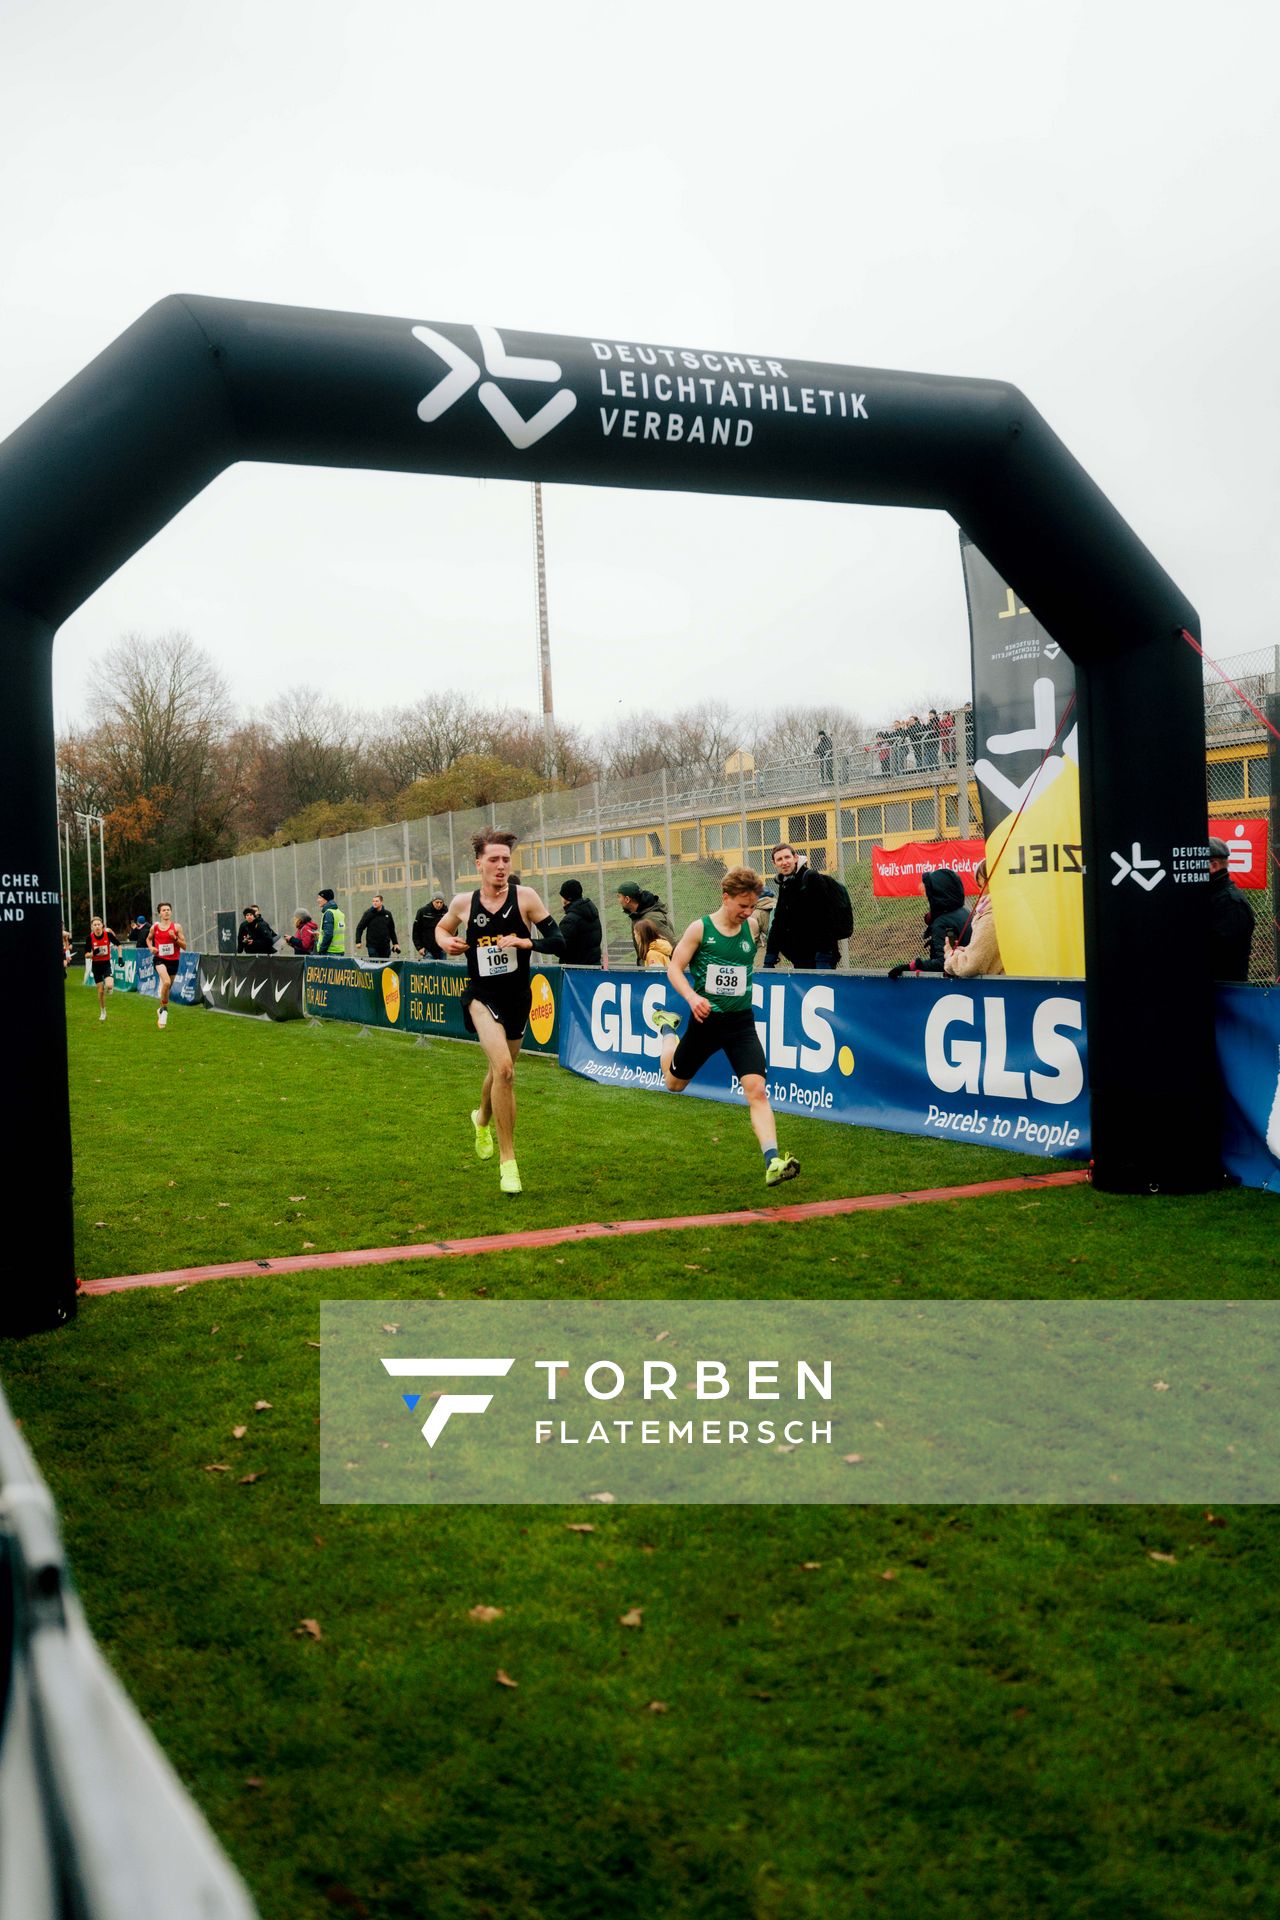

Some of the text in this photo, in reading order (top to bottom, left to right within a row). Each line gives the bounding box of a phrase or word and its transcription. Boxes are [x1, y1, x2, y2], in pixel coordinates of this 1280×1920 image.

[590, 341, 789, 379] DEUTSCHER
[599, 367, 869, 420] LEICHTATHLETIK
[599, 407, 754, 447] VERBAND
[2, 873, 39, 887] CHER
[900, 863, 914, 876] um
[951, 858, 972, 873] Geld
[486, 953, 509, 966] 106
[719, 966, 735, 975] GLS
[410, 974, 439, 996] EINFACH
[715, 974, 739, 988] 638
[410, 997, 424, 1021] FÜR
[530, 1002, 553, 1022] entega
[591, 981, 667, 1058] GLS
[924, 993, 1084, 1105] GLS
[583, 1060, 666, 1089] Parcels to People
[774, 1080, 787, 1102] to
[789, 1081, 834, 1112] People
[924, 1104, 1080, 1151] Parcels to People
